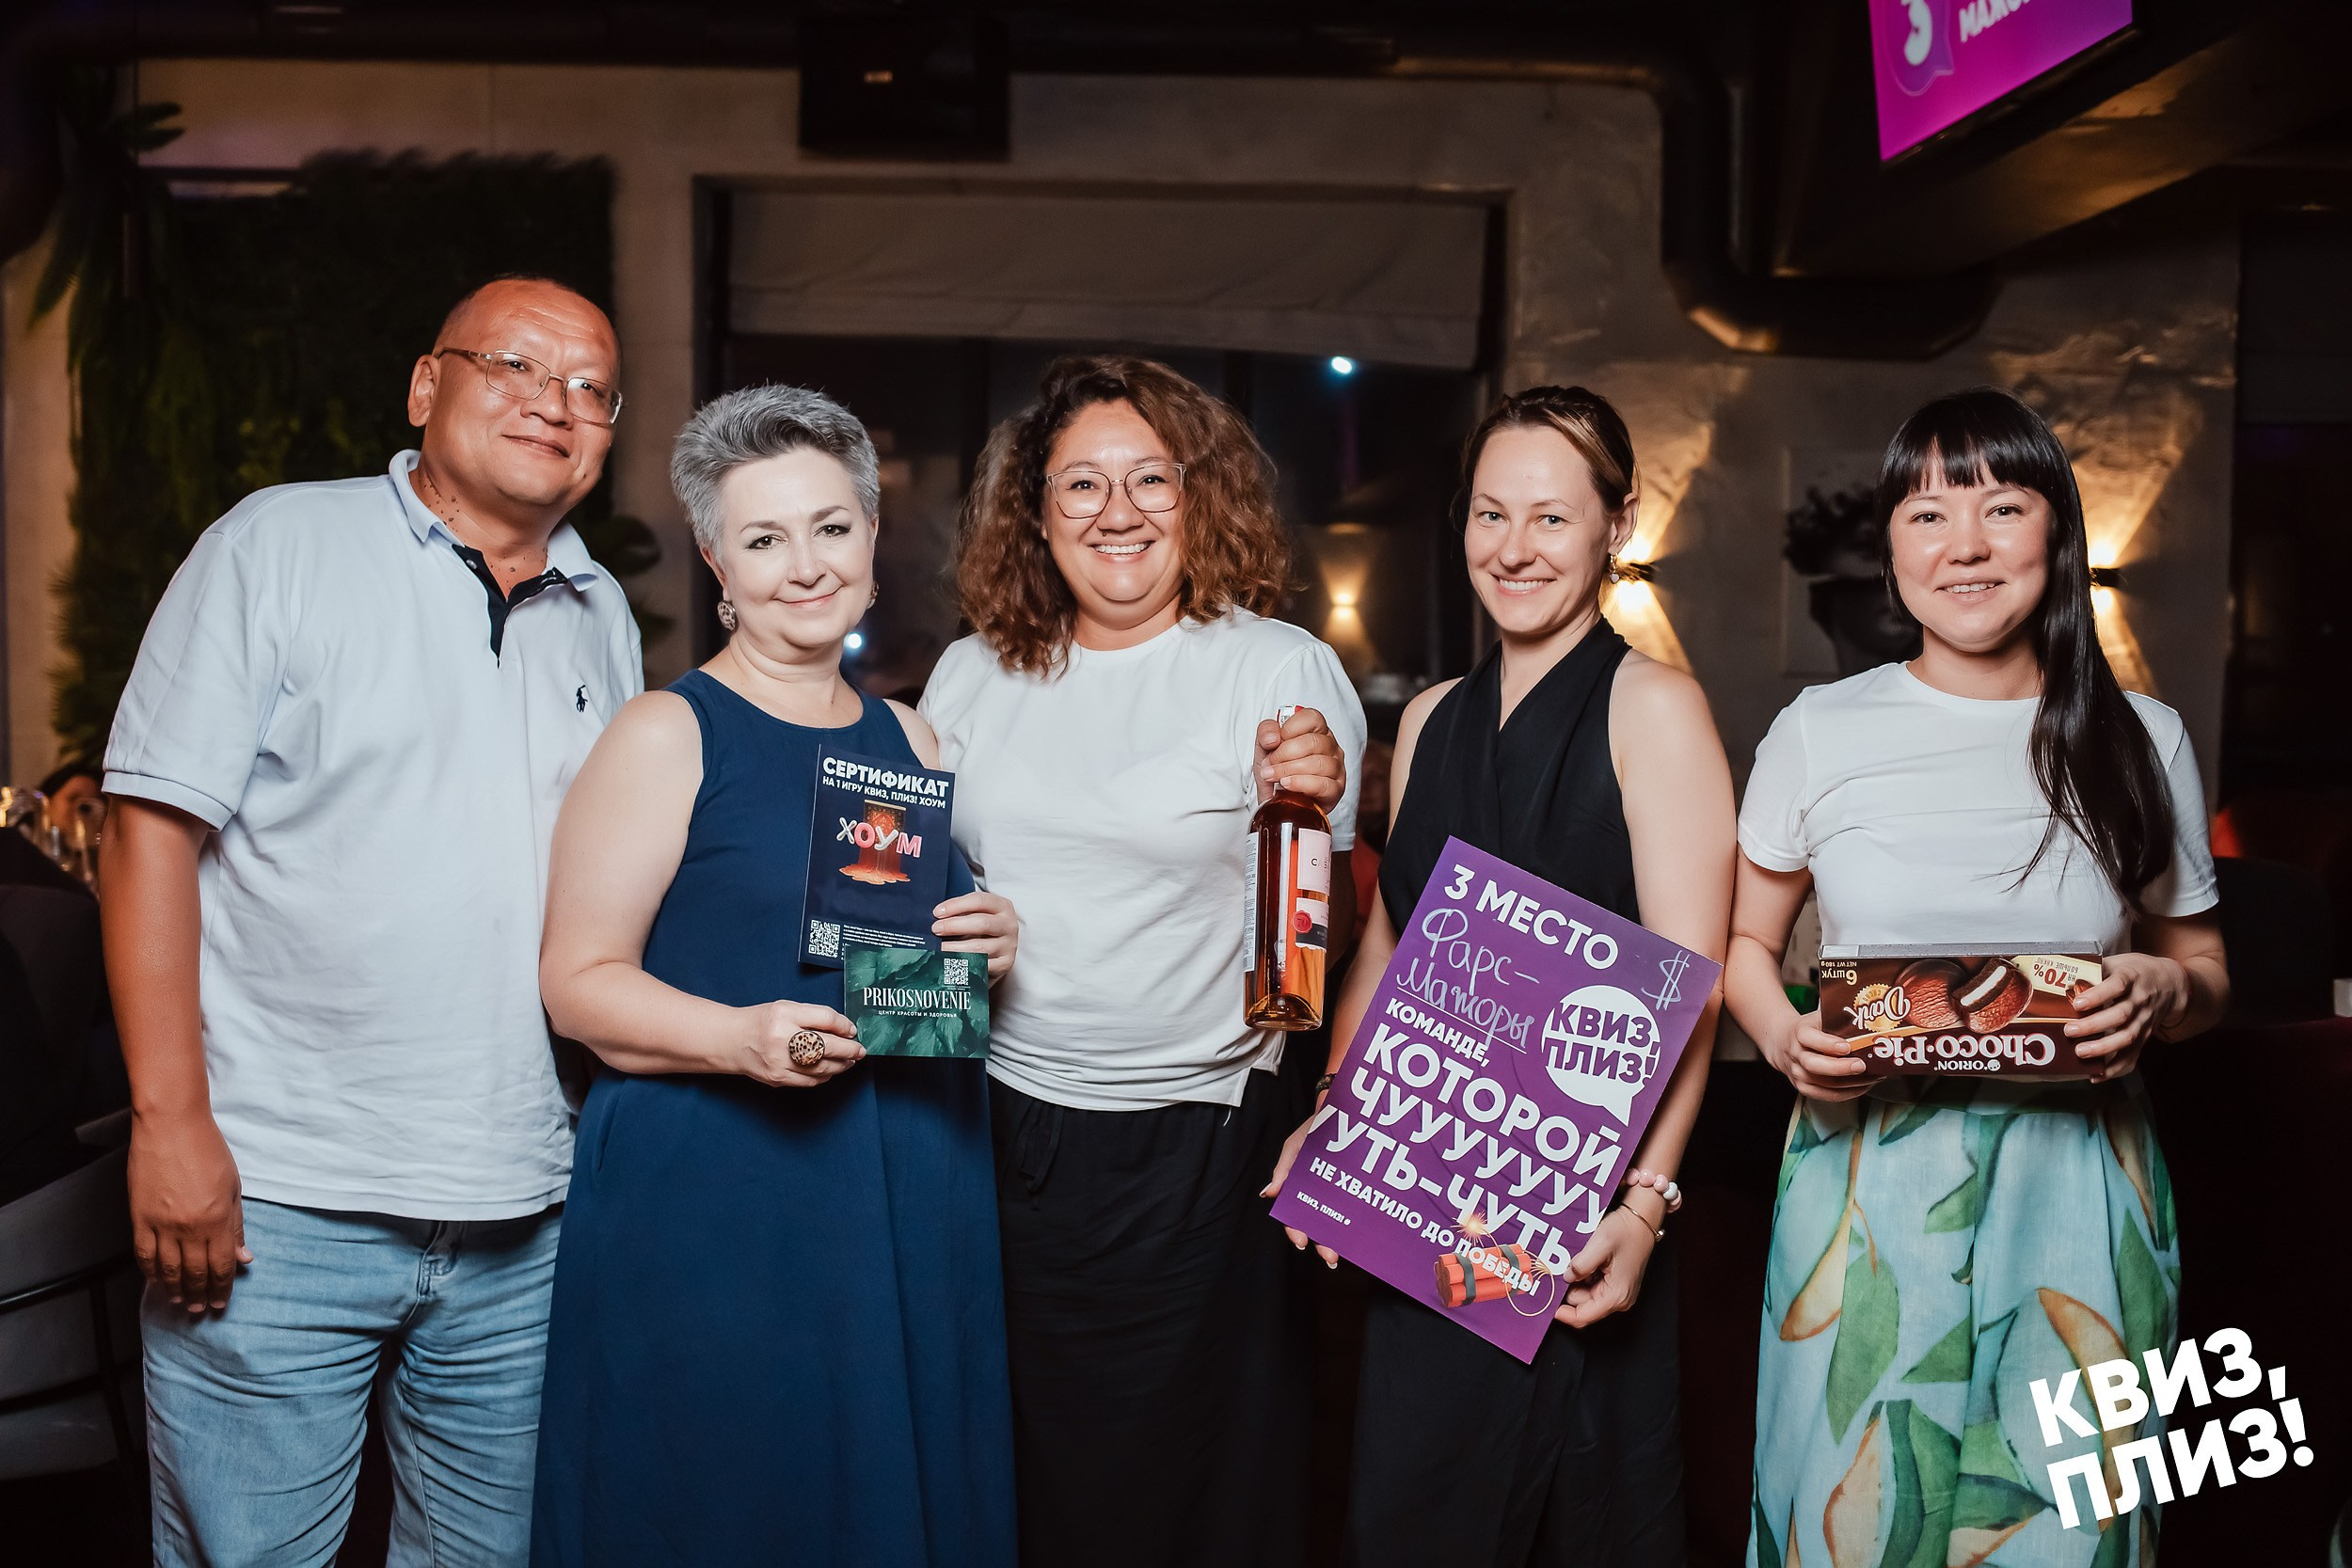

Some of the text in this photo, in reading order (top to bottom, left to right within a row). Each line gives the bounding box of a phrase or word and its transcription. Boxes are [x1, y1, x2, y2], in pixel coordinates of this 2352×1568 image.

[822, 757, 949, 798] СЕРТИФИКАТ
[822, 776, 946, 809] НА 1 ИГРУ КВИЗ, ПЛИЗ! ХОУМ
[836, 816, 923, 858] ХОУМ
[1444, 863, 1619, 970] 3 МЕСТО
[1422, 908, 1540, 996] Фарс-
[1641, 950, 1691, 1010] $
[1846, 969, 1858, 986] 6
[2034, 964, 2068, 989] 70%
[863, 988, 972, 1010] PRIKOSNOVENIE
[1843, 986, 1912, 1030] Dark
[1386, 997, 1489, 1068] КОМАНДЕ,
[1550, 1002, 1661, 1057] КВИЗ,
[1544, 1037, 1657, 1087] ПЛИЗ!
[1938, 1059, 1984, 1070] ORION
[1363, 1022, 1623, 1188] КОТОРОЙ
[1296, 1191, 1344, 1223] КВИЗ, ПЛИЗ!
[1310, 1157, 1541, 1296] НЕ ХВАТИЛО ДО ПОБЕДЫ
